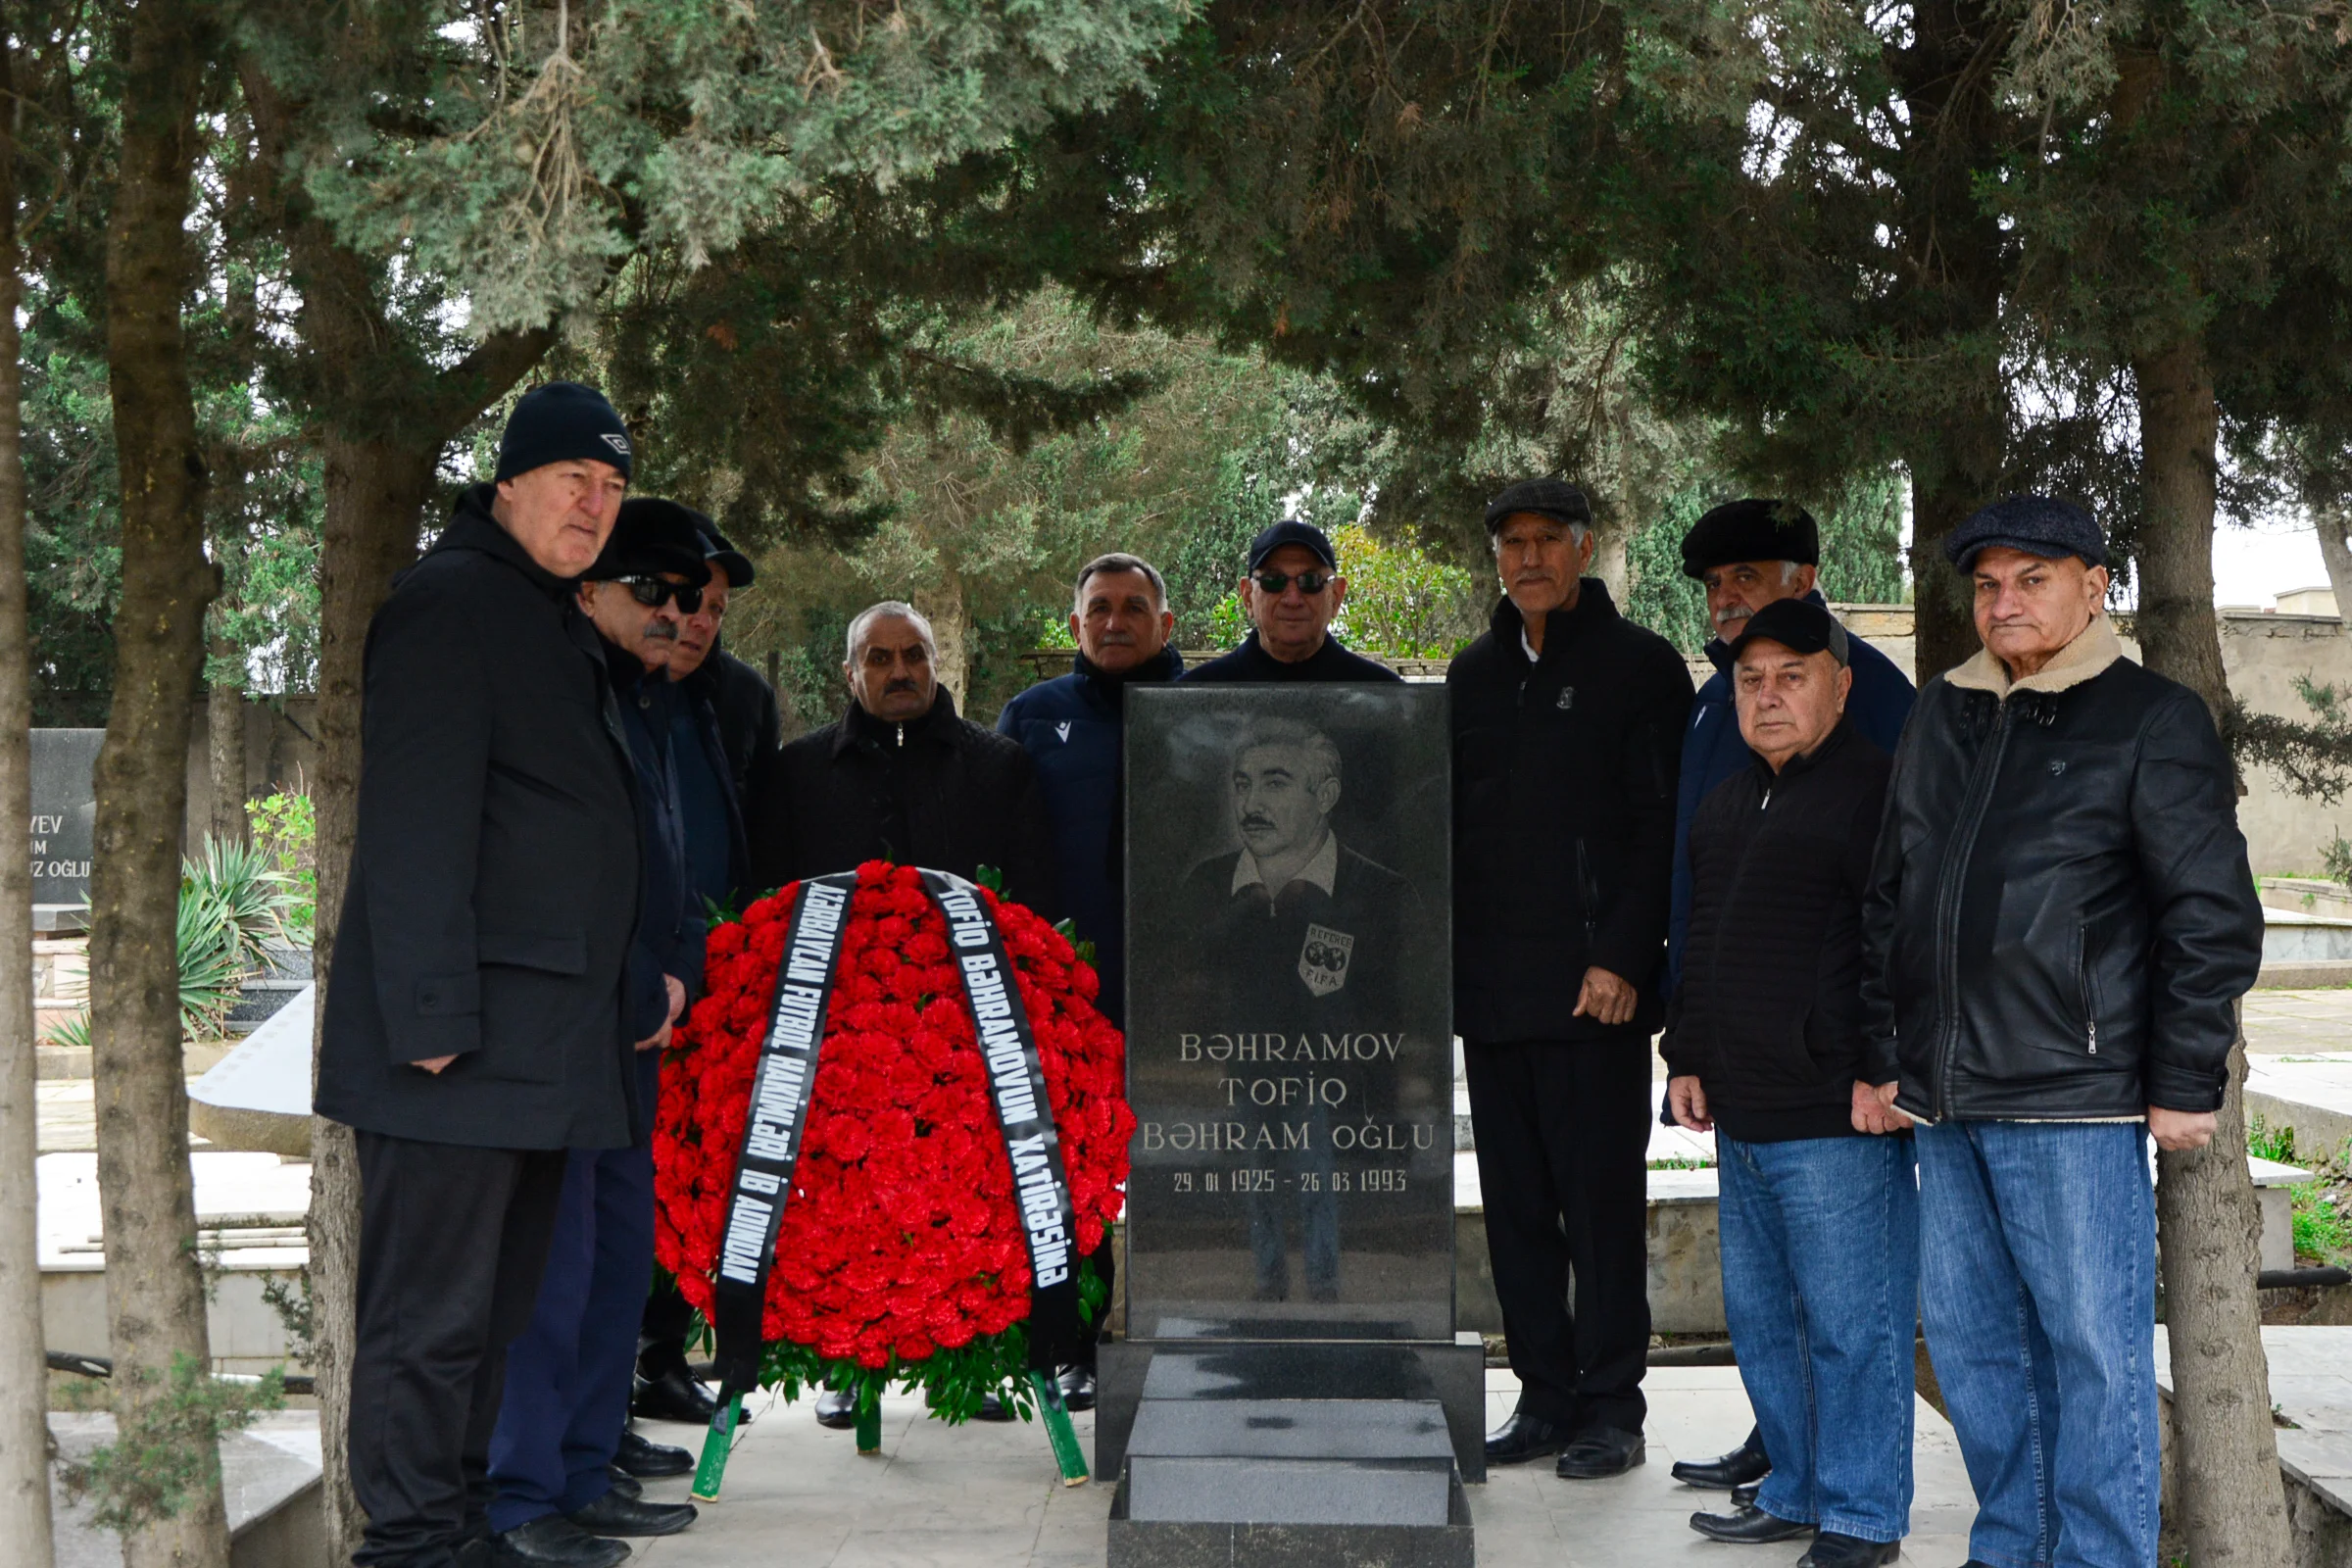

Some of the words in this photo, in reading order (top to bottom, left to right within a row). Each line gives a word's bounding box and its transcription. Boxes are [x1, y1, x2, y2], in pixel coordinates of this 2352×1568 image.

[48, 858, 91, 877] OĞLU
[787, 882, 847, 983] AZƏRBAYCAN
[939, 888, 992, 947] TOFİQ
[1310, 926, 1352, 949] REFEREE
[772, 984, 821, 1050] FUTBOL
[961, 954, 1038, 1125] BƏHRAMOVUN
[1179, 1033, 1406, 1061] BƏHRAMOV
[747, 1054, 807, 1160] HAKİMLƏRİ
[1218, 1071, 1348, 1108] TOFİQ
[1144, 1122, 1310, 1151] BƏHRAM
[1332, 1116, 1435, 1151] OĞLU
[722, 1195, 773, 1284] ADINDAN
[1009, 1133, 1072, 1289] XATİRƏSİNƏ
